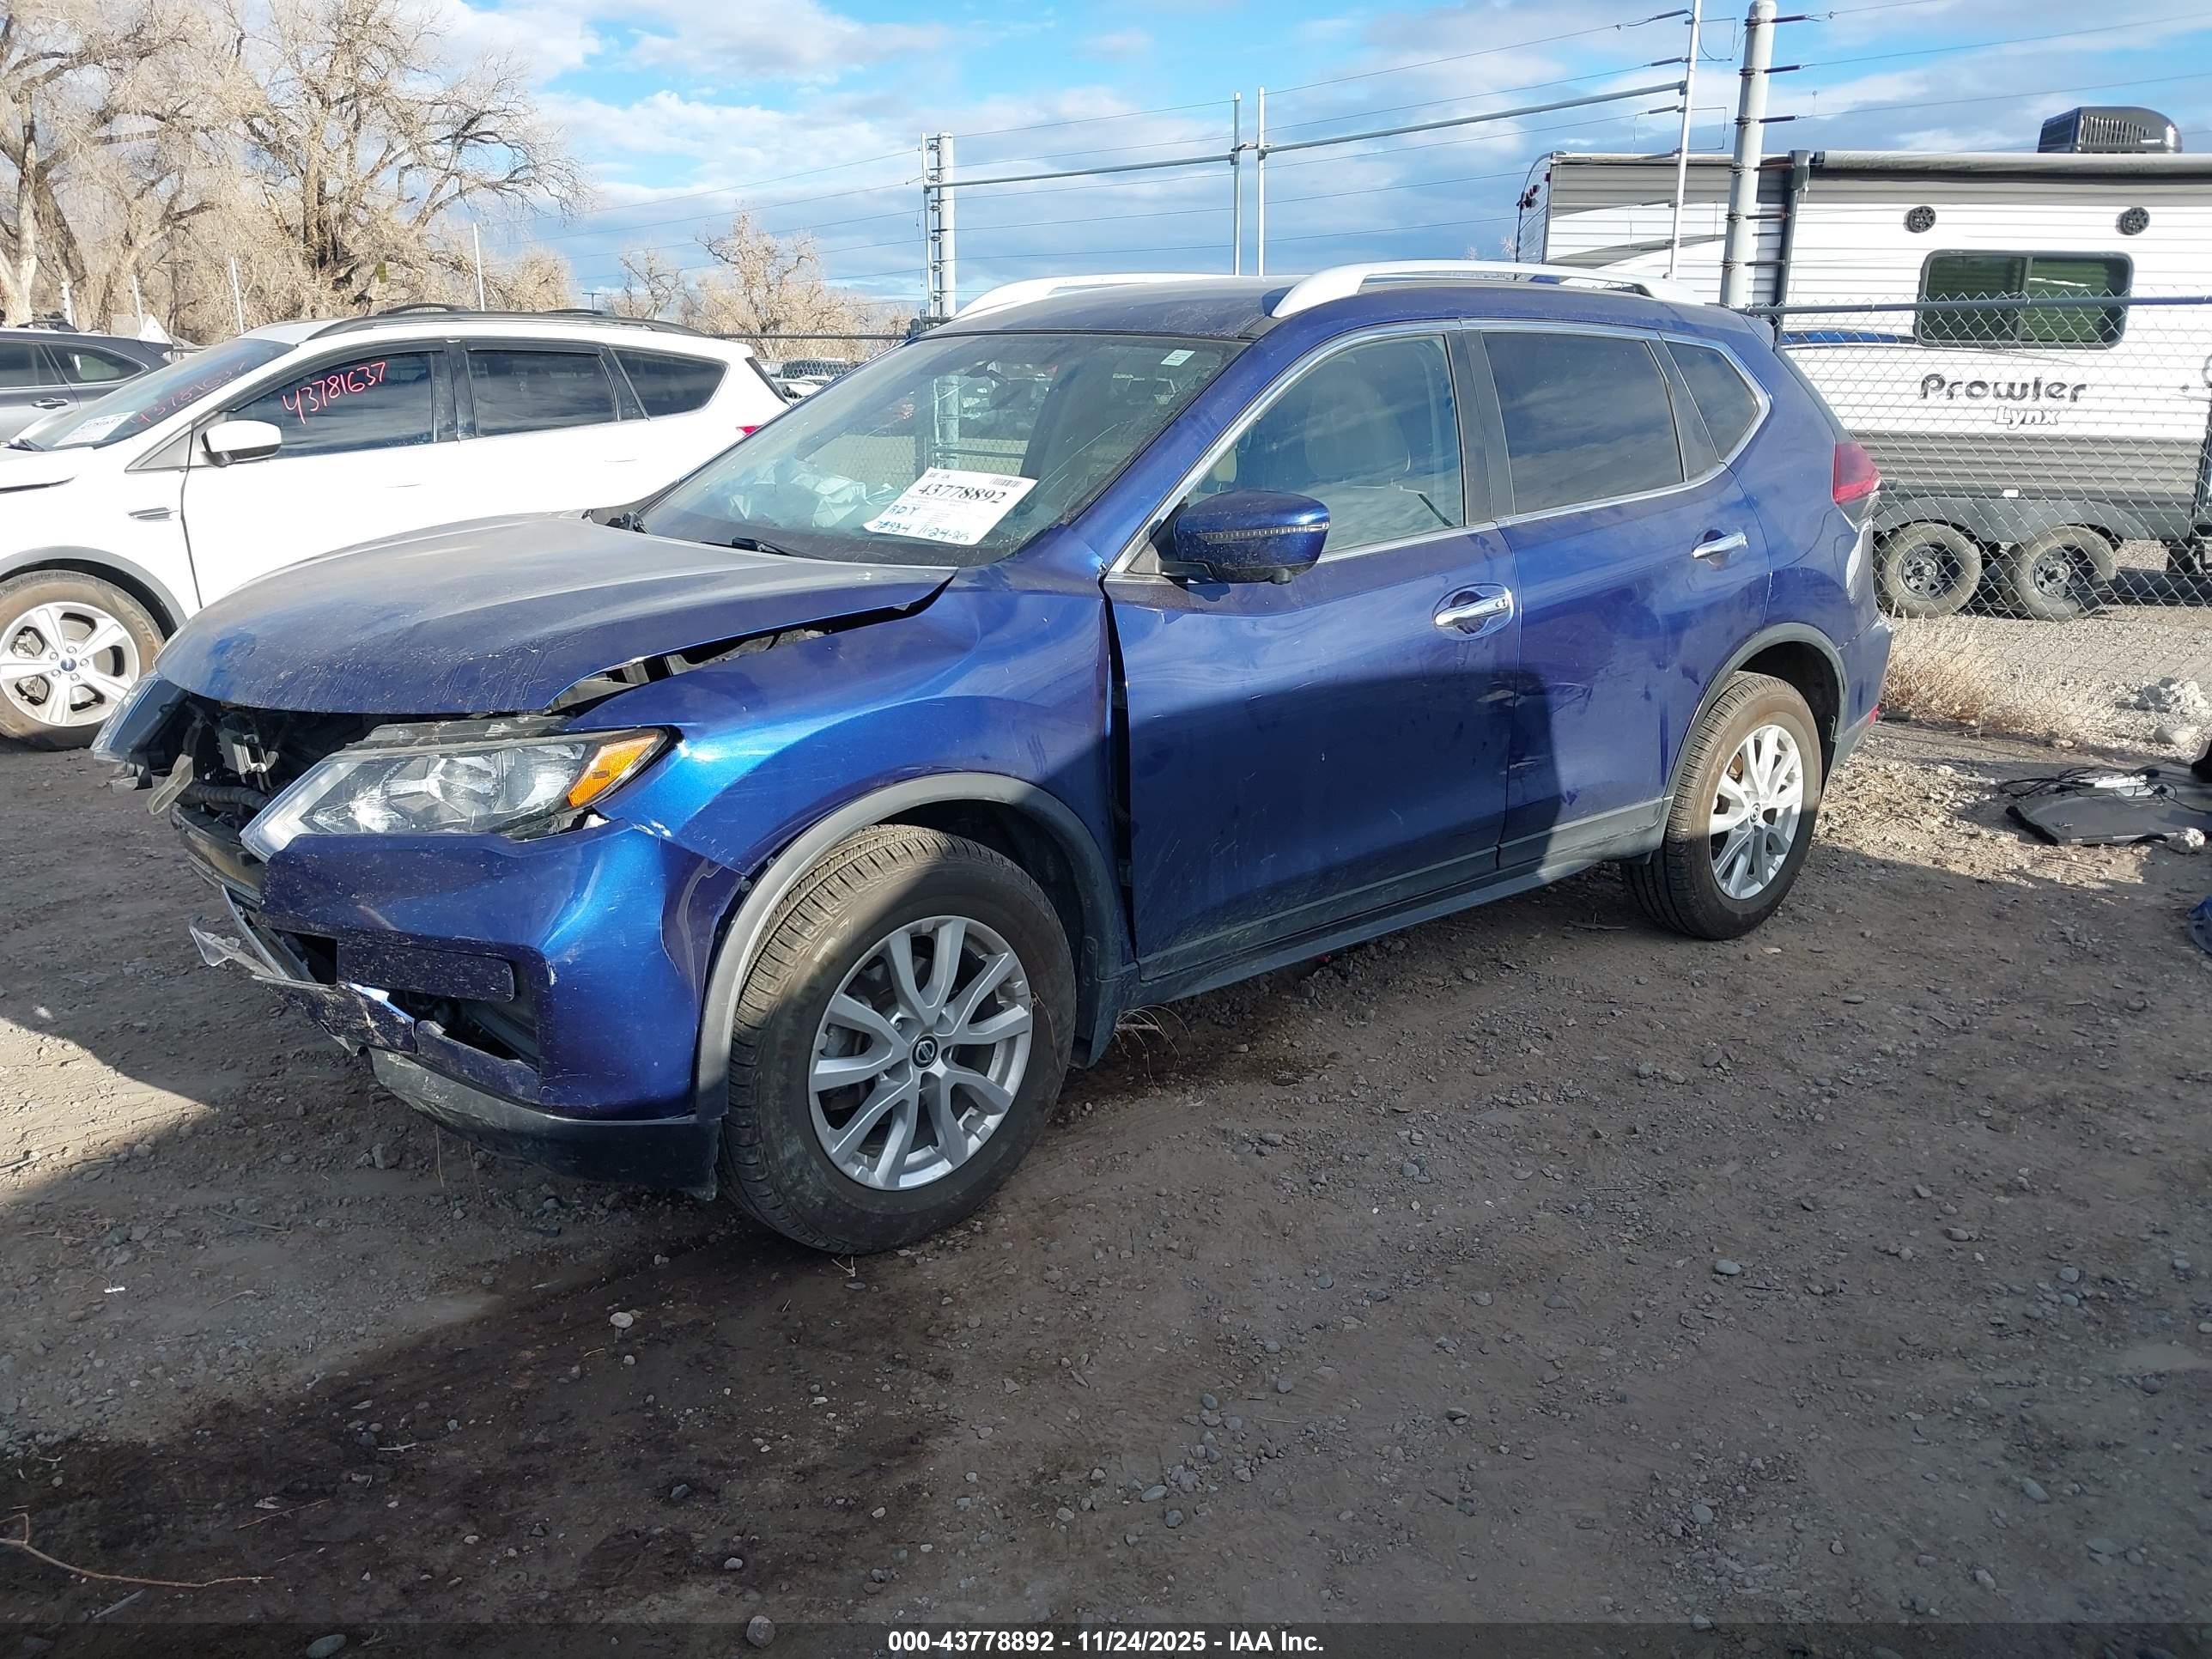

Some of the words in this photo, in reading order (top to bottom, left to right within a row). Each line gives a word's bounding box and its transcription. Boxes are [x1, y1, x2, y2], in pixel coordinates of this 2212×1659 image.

[283, 362, 386, 424] 43781637
[1918, 374, 2087, 402] Prowler
[1995, 405, 2060, 430] Lynx
[918, 483, 1006, 503] 43778892
